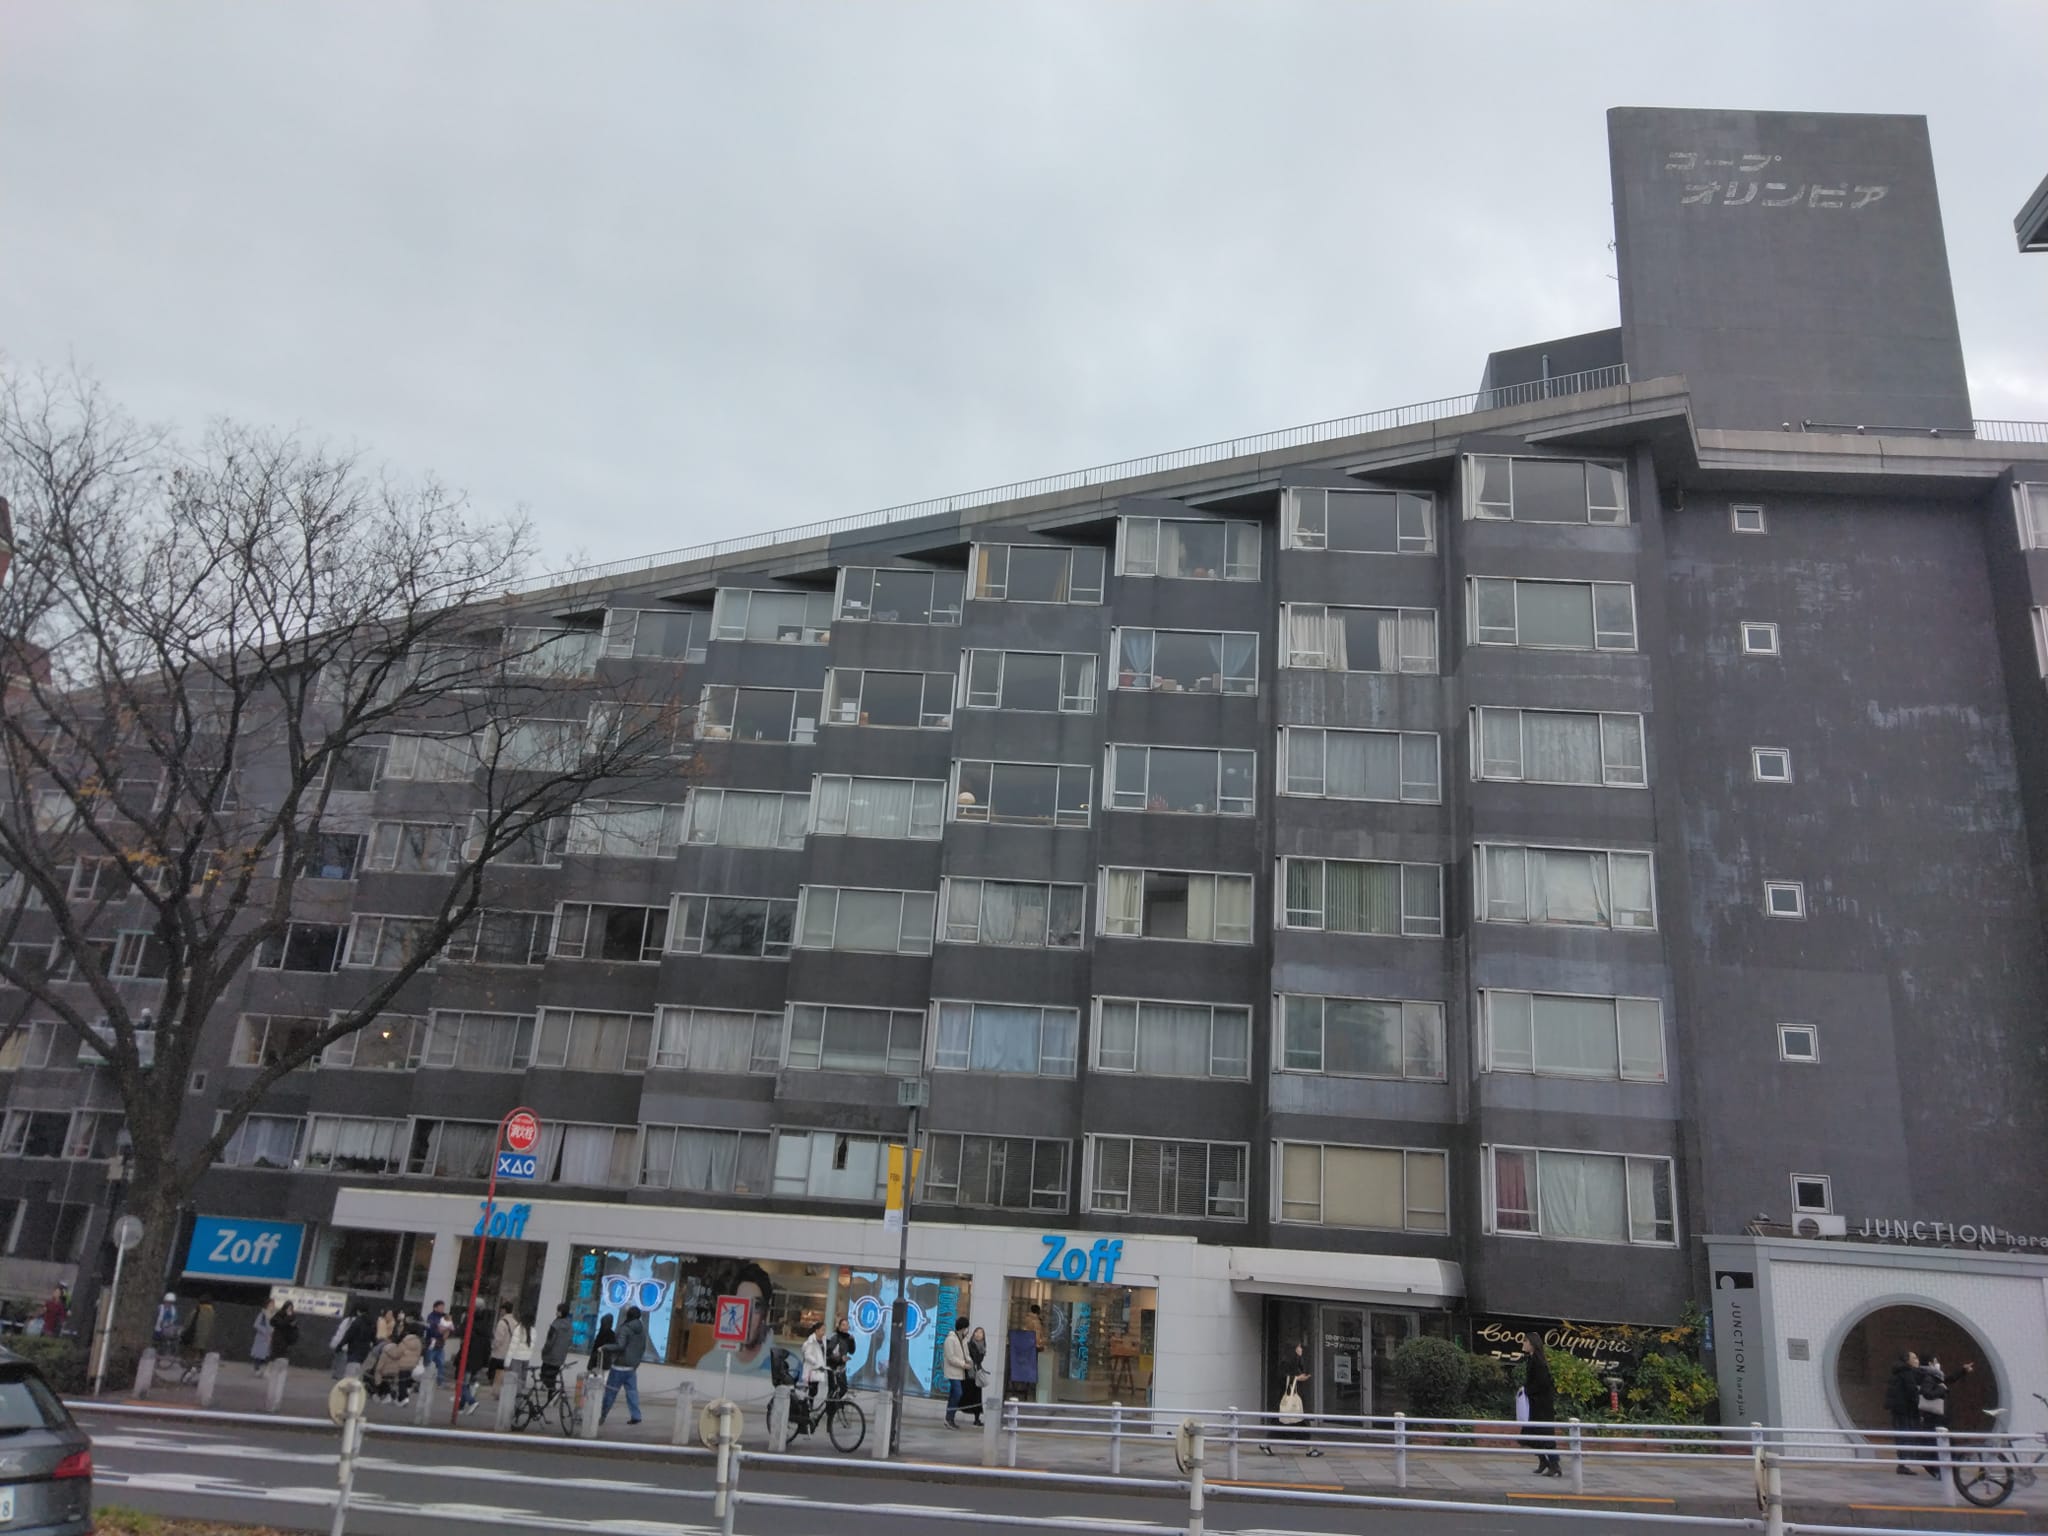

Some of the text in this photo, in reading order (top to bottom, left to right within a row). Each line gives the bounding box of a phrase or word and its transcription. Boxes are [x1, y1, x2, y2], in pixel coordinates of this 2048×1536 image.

[1665, 151, 1782, 172] コープ
[1680, 180, 1889, 208] オリンピア
[473, 1201, 531, 1239] Zoff
[1858, 1217, 1997, 1245] JUNCTION
[208, 1228, 282, 1265] Zoff
[1036, 1234, 1124, 1284] Zoff
[1477, 1323, 1526, 1343] Co-o
[1731, 1302, 1745, 1373] JUNCTION
